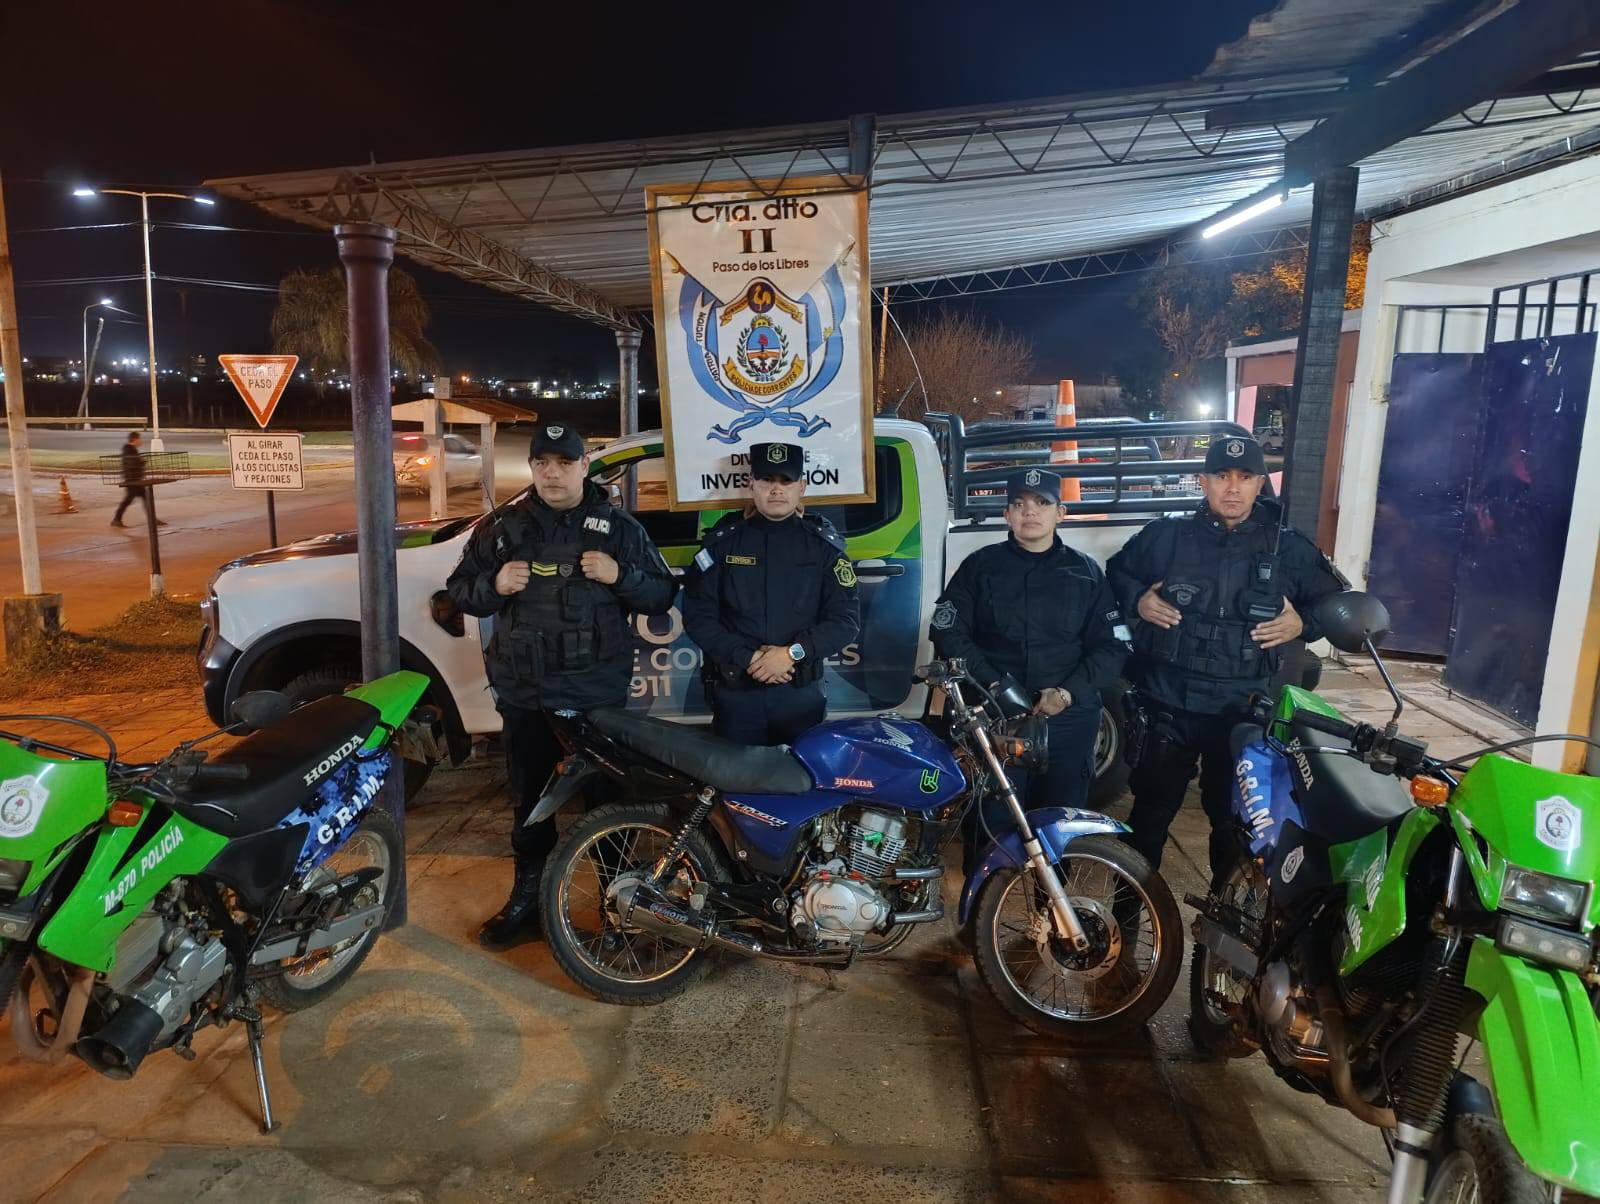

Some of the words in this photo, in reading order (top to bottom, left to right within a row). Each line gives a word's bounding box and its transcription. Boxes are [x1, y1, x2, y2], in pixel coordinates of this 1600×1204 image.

[738, 228, 777, 254] II
[712, 261, 740, 273] Paso
[742, 260, 758, 271] de
[759, 259, 775, 271] los
[776, 258, 809, 270] Libres
[240, 366, 265, 377] CEDA
[267, 366, 279, 377] EL
[248, 379, 272, 389] PASO
[247, 440, 257, 449] AL
[258, 440, 283, 449] GIRAR
[238, 452, 259, 461] CEDA
[261, 452, 271, 461] EL
[273, 452, 294, 461] PASO
[235, 463, 240, 472] A
[242, 463, 257, 472] LOS
[259, 463, 299, 473] CICLISTAS
[244, 475, 249, 484] Y
[251, 475, 291, 484] PEATONES
[629, 676, 671, 697] 911
[872, 737, 912, 753] HONDA
[303, 734, 365, 786] HONDA
[834, 777, 875, 789] HONDA
[317, 775, 385, 845] G.R.I.M.
[141, 825, 184, 877] POLICÍA
